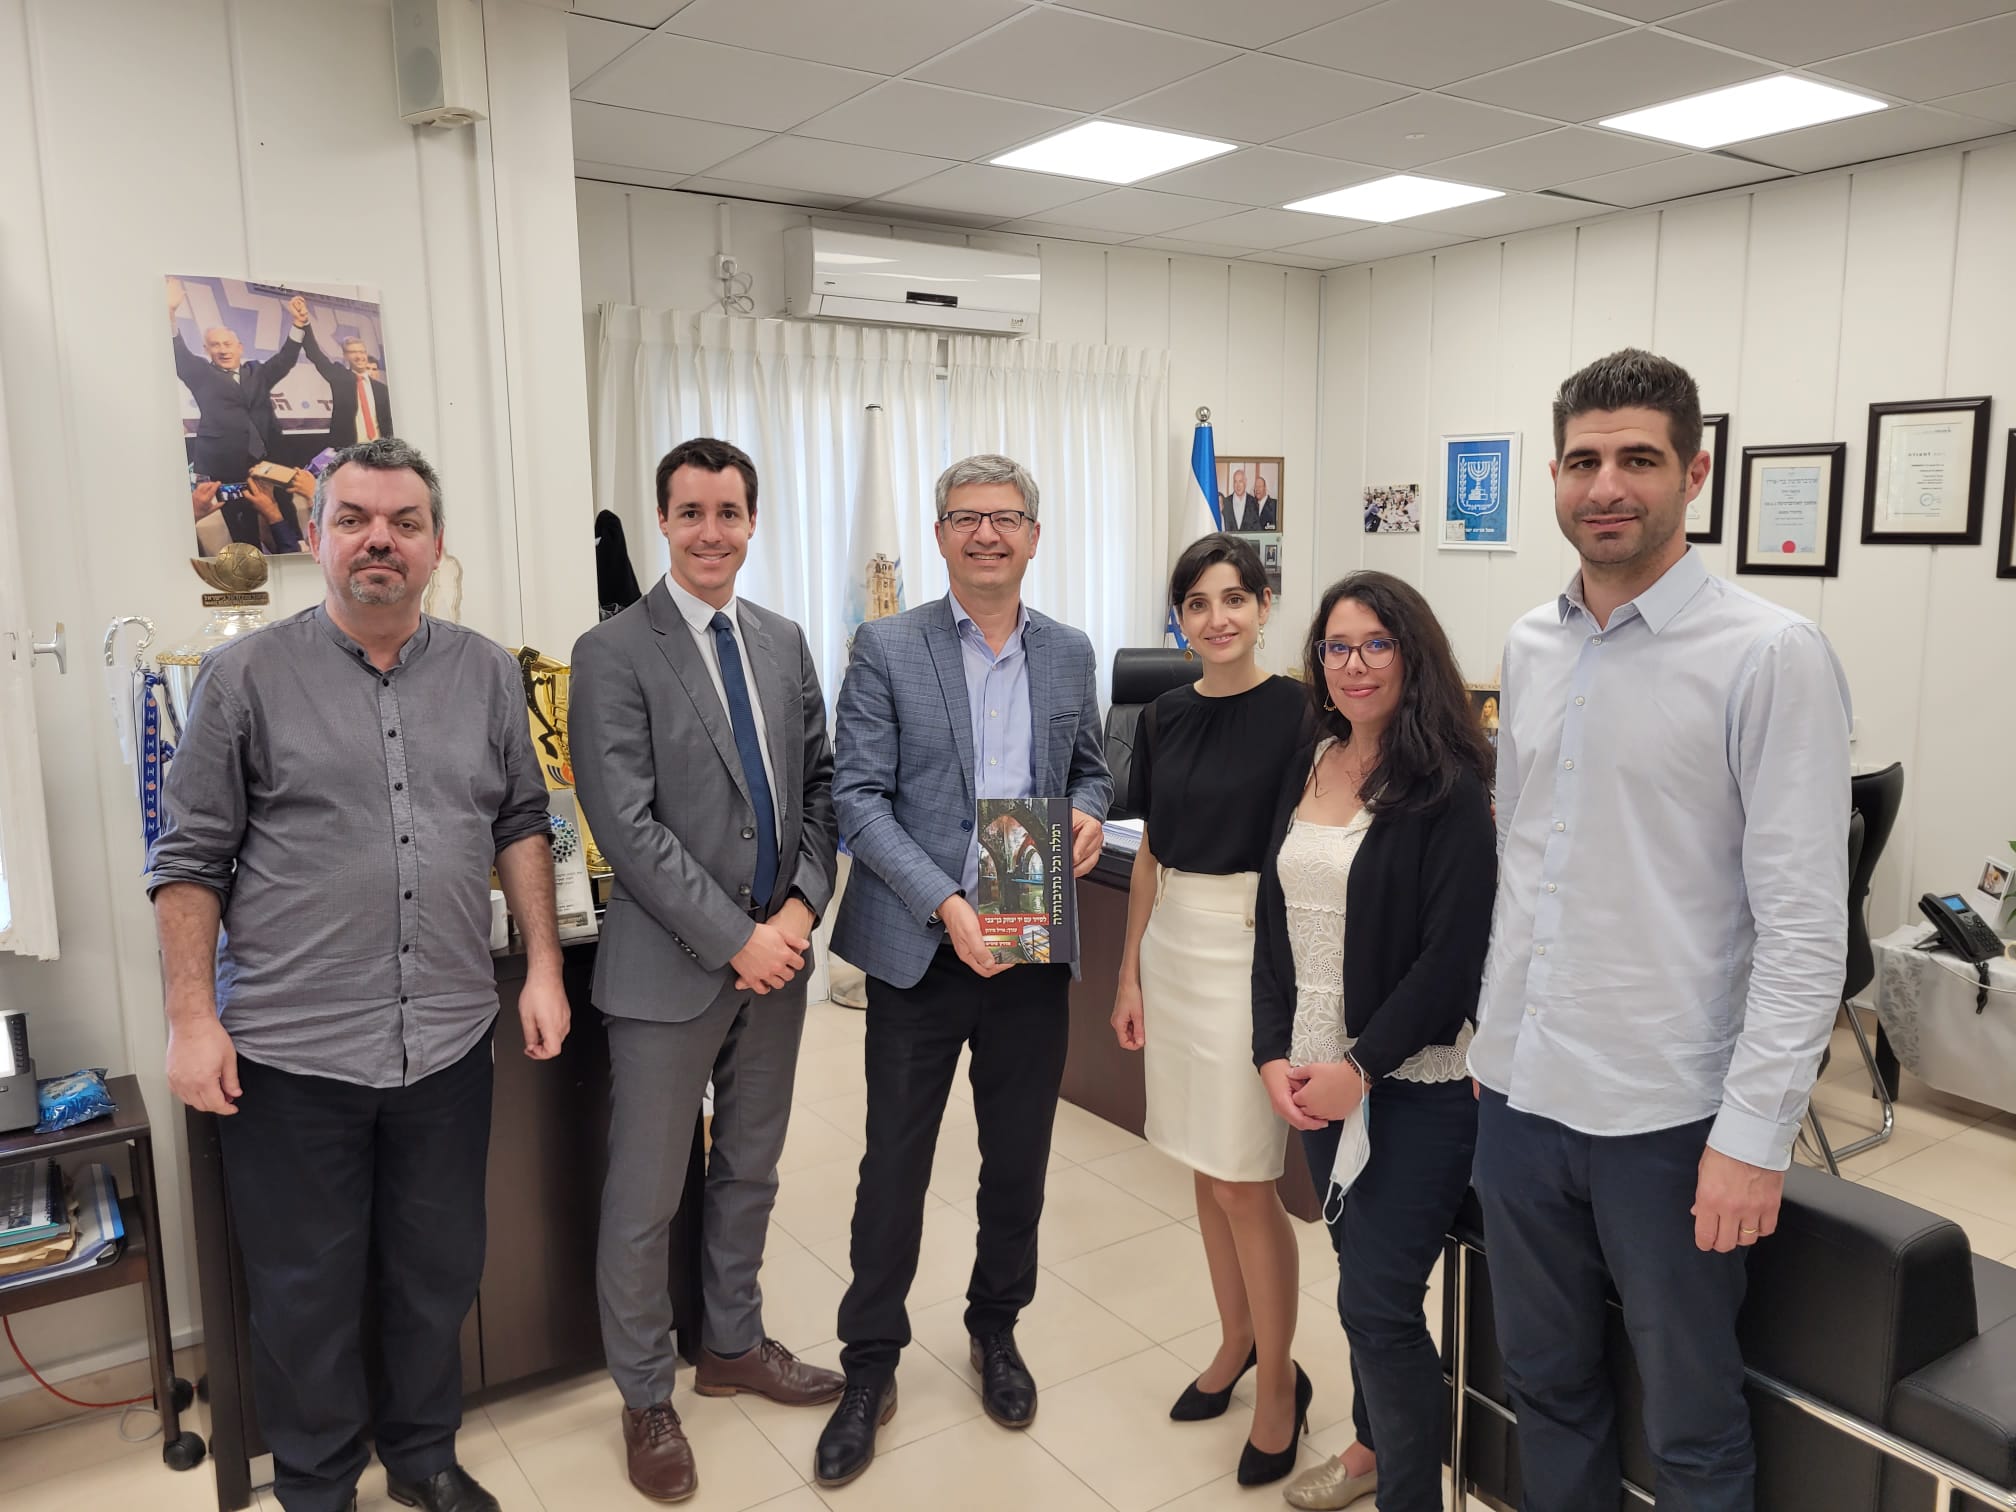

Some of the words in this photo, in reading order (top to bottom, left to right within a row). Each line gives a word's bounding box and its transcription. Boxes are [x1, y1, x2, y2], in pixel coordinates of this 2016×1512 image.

[1049, 823, 1062, 852] רמלה
[1049, 855, 1062, 873] וכל
[1052, 876, 1062, 926] נתיבותיה
